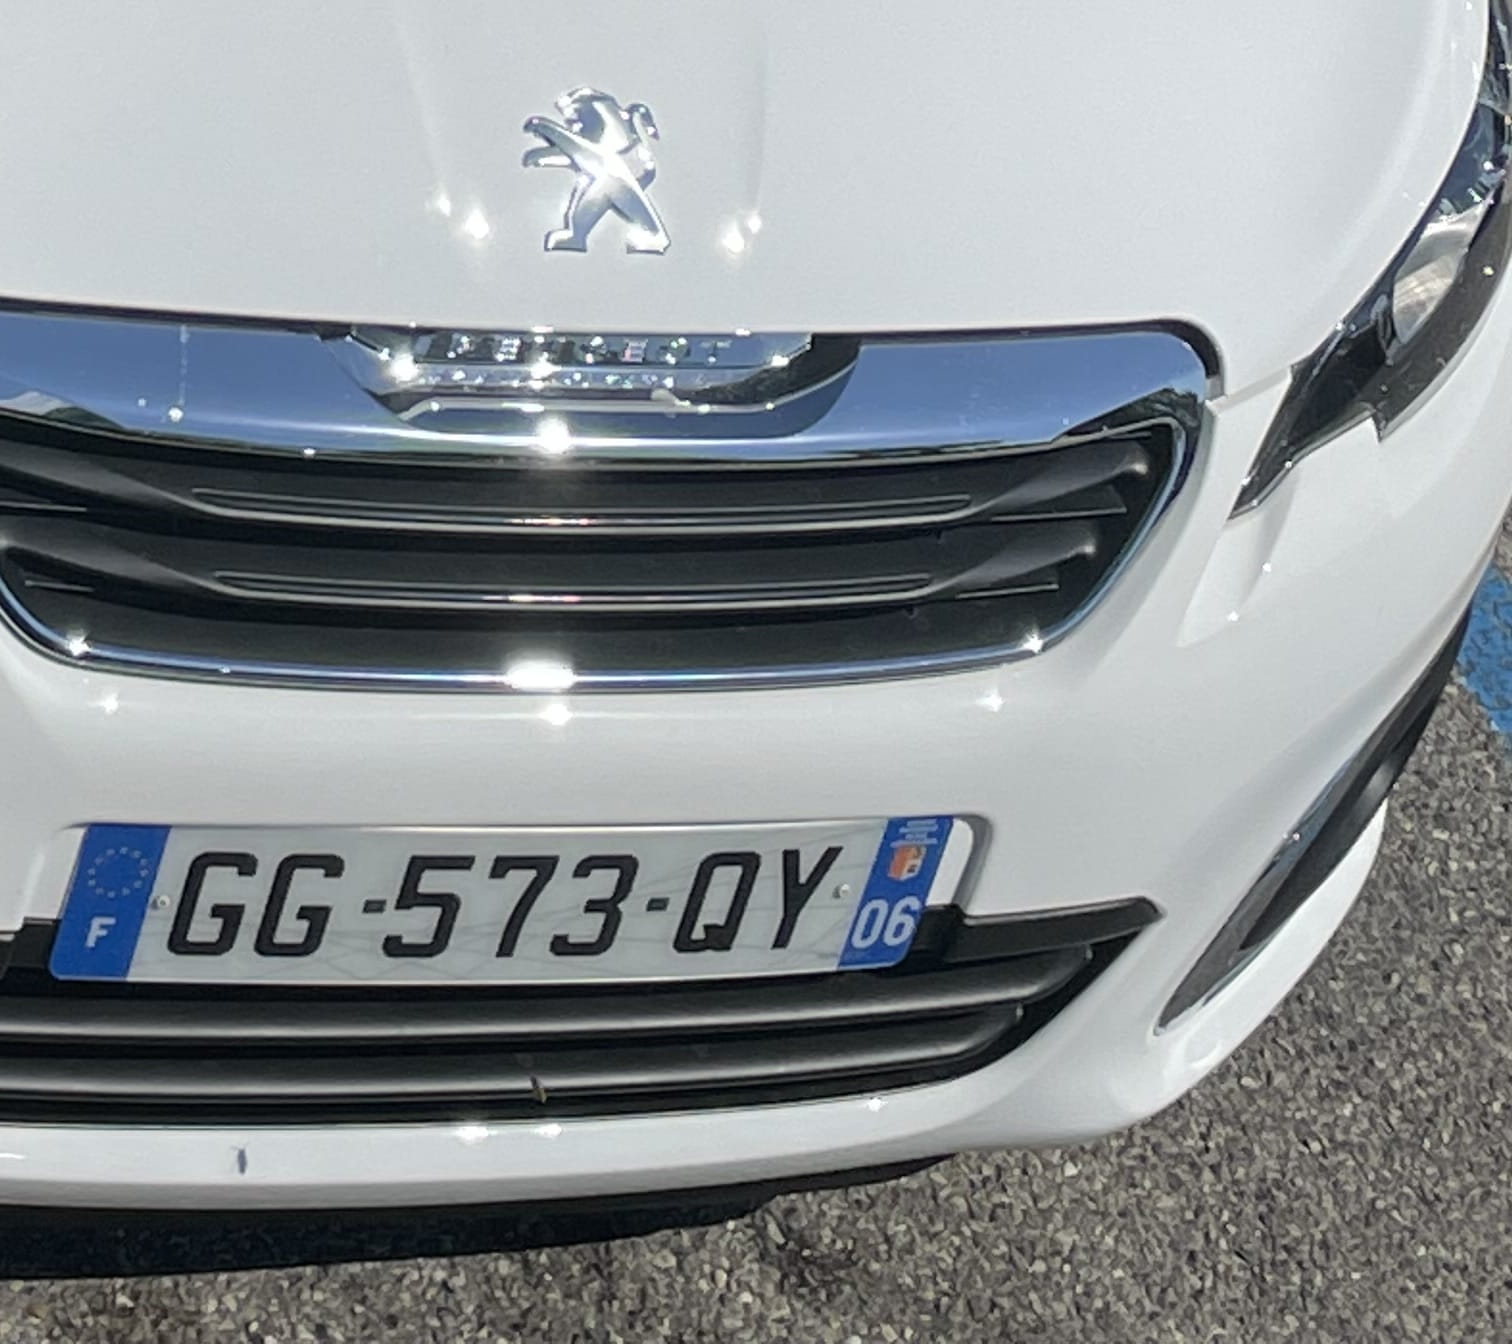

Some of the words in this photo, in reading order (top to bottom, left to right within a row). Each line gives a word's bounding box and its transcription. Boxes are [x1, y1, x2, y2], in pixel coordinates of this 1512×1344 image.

[167, 846, 844, 958] GG-573-QY
[850, 895, 922, 949] 06
[85, 916, 117, 949] F
